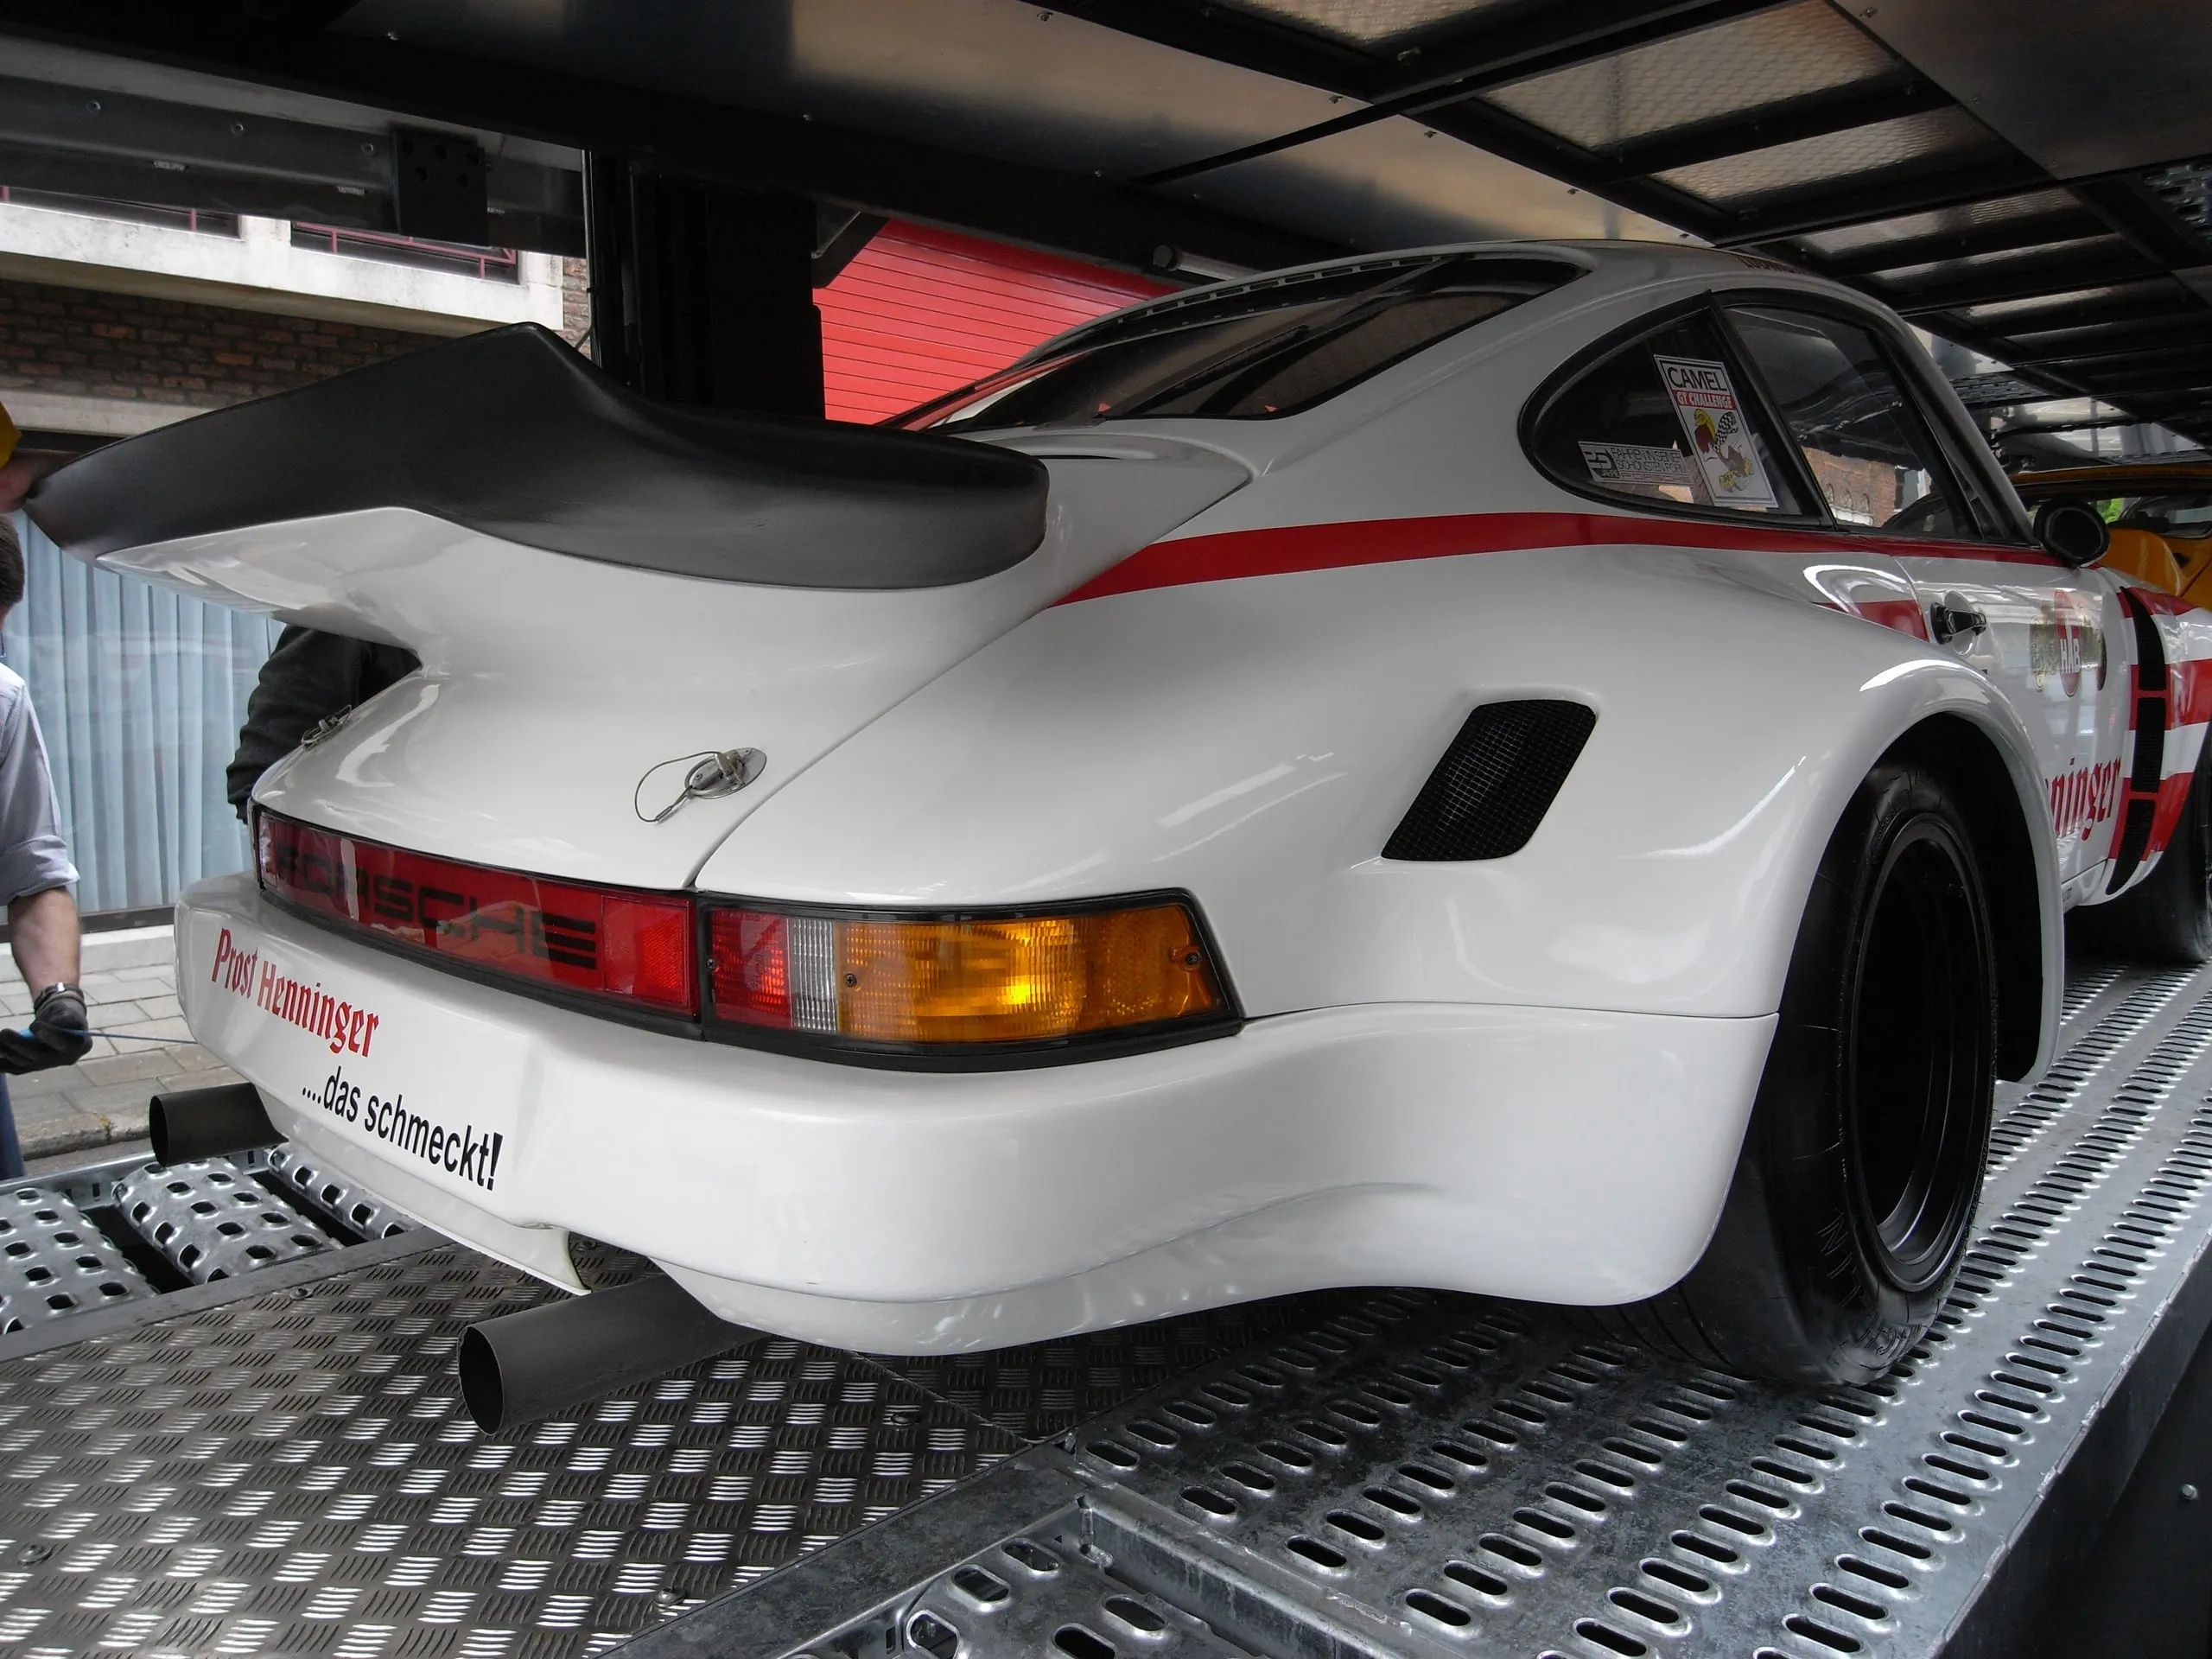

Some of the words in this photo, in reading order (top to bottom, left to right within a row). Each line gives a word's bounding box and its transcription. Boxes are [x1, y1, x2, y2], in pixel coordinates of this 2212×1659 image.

[1668, 367, 1727, 391] CAMEL
[1676, 391, 1688, 404] GT
[1688, 392, 1732, 409] CHALLENGE
[2045, 757, 2122, 842] ninger
[276, 844, 597, 970] PORSCHE
[211, 927, 258, 999] Prost
[257, 960, 380, 1058] Henninger
[364, 1094, 504, 1192] schmeckt!
